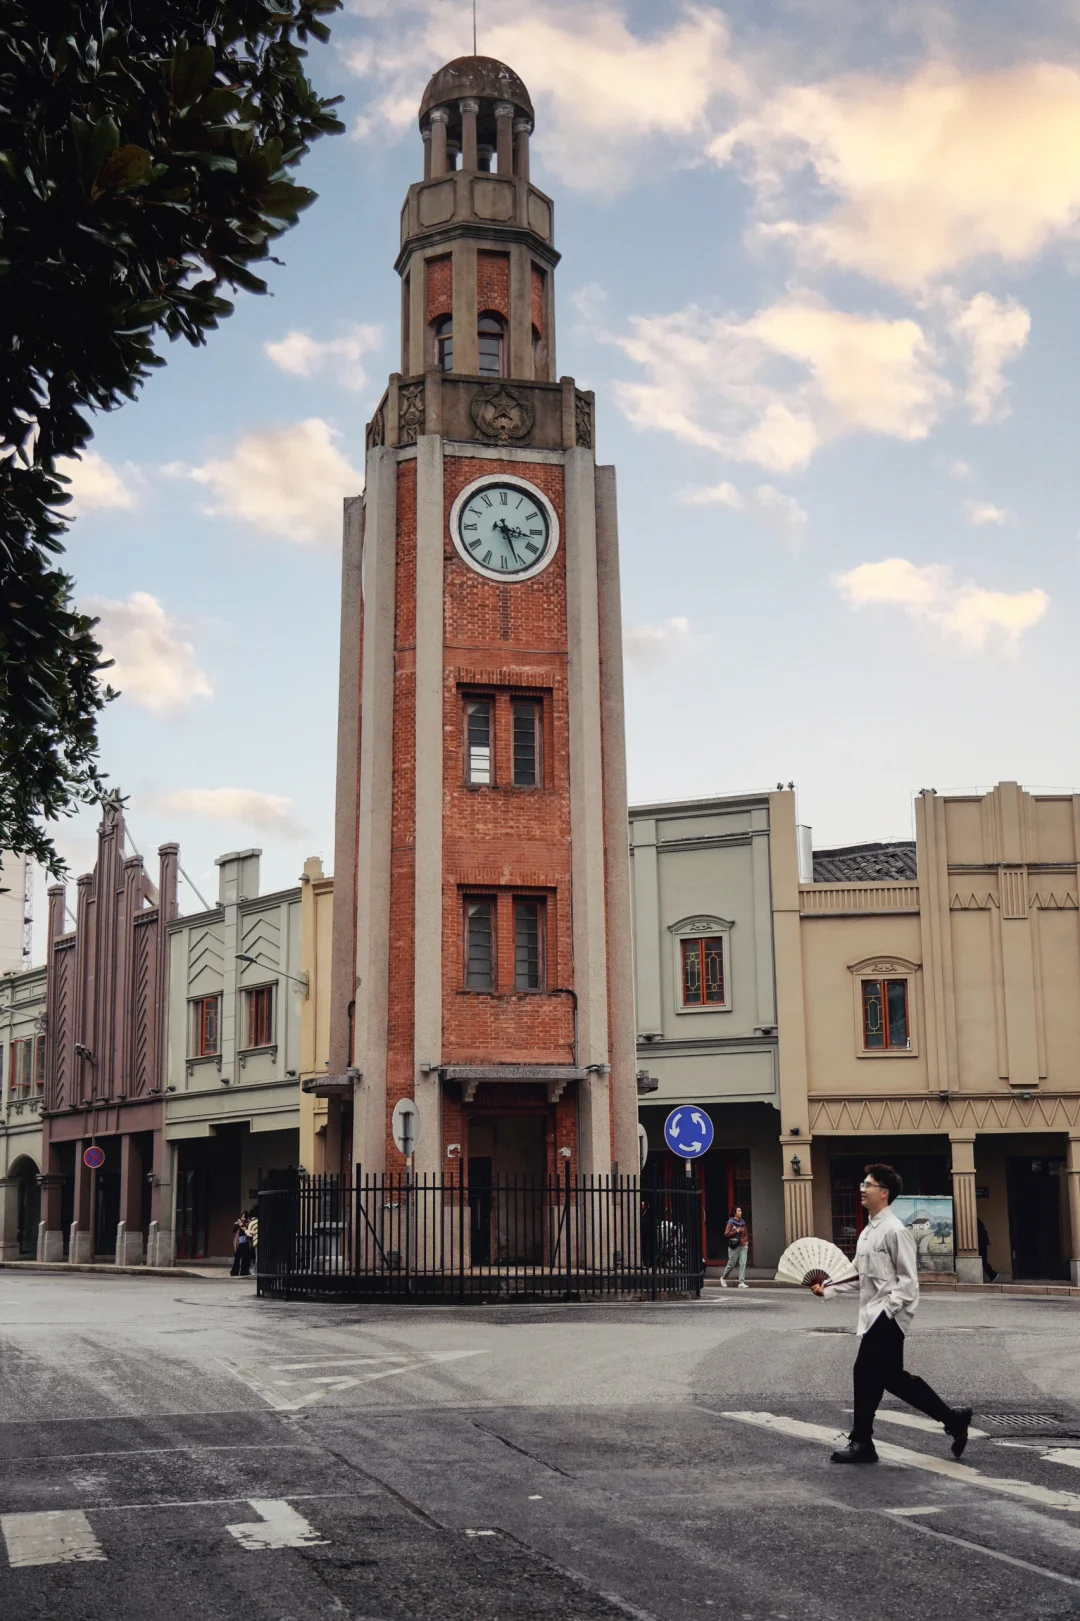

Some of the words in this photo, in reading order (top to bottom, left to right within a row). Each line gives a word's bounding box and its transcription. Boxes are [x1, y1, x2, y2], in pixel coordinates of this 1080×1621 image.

[480, 494, 493, 508] XI
[515, 498, 524, 510] I
[468, 506, 482, 518] X
[525, 511, 539, 521] II
[463, 523, 477, 531] IX
[468, 538, 482, 551] VIII
[524, 541, 540, 555] IIII
[481, 550, 493, 565] VII
[500, 555, 508, 569] VI
[517, 553, 526, 567] V
